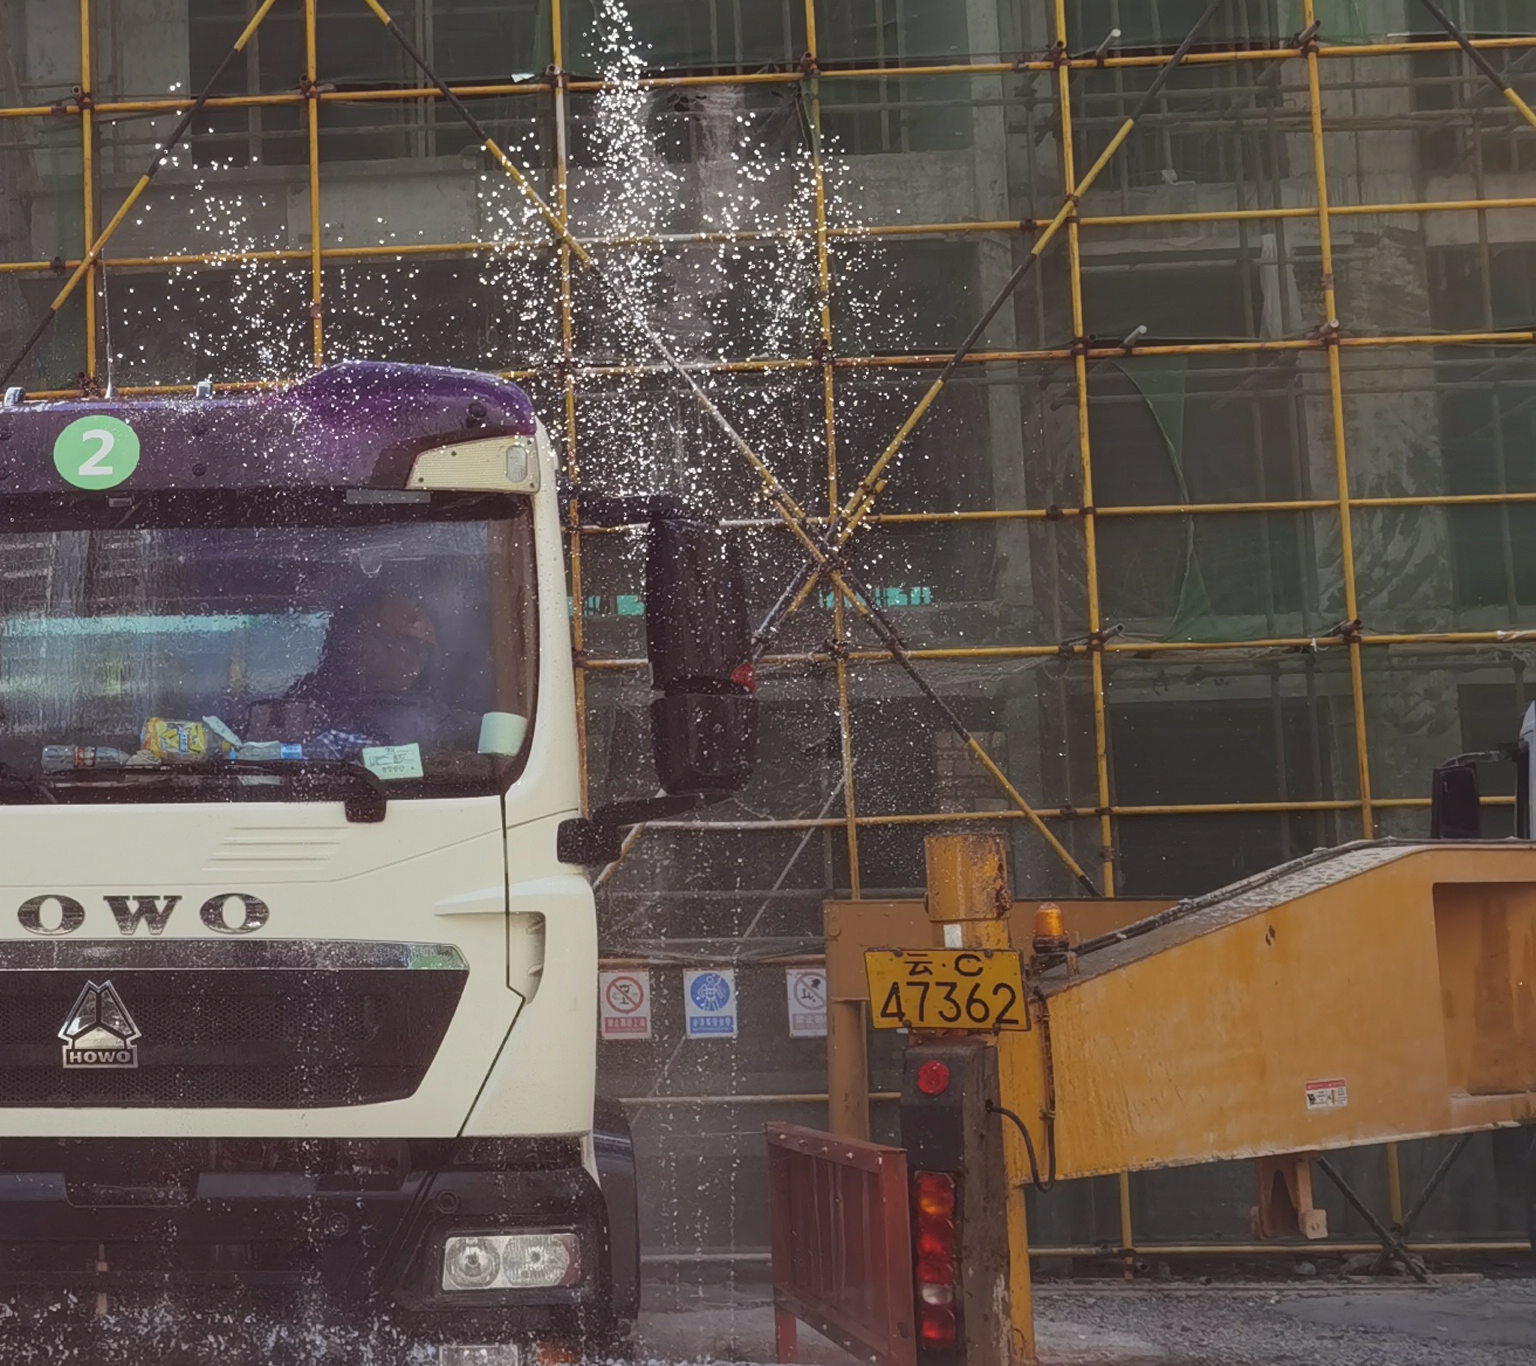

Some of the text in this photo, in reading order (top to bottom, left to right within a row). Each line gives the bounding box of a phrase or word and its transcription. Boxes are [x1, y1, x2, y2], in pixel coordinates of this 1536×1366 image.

[78, 428, 115, 476] 2
[880, 981, 1019, 1025] 47362
[69, 1051, 131, 1063] HOWO
